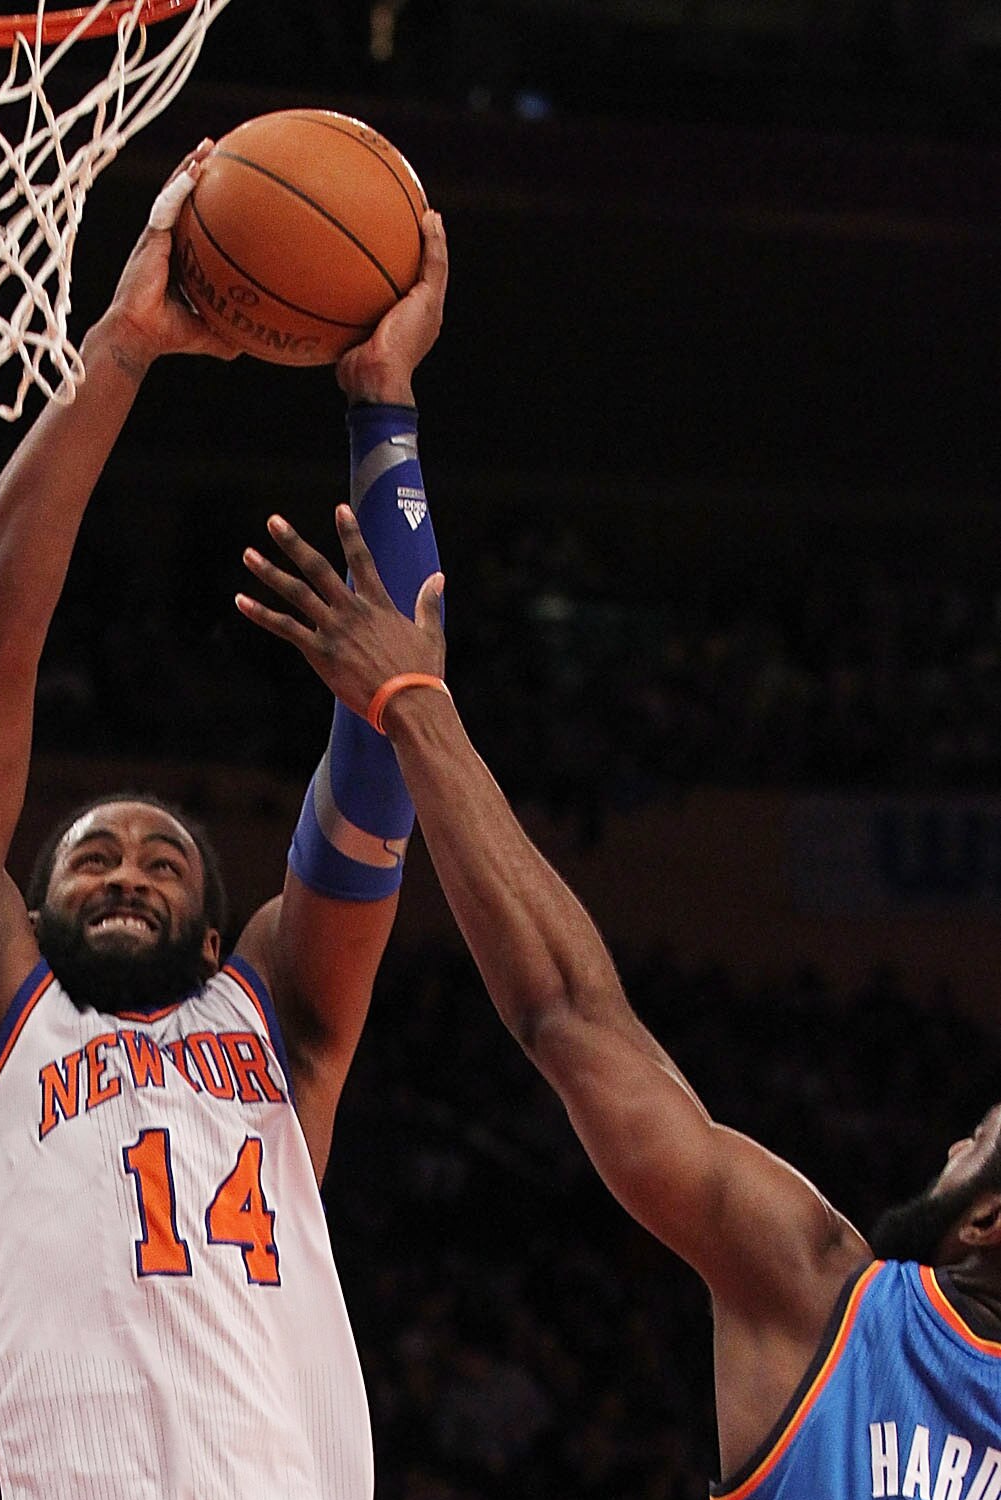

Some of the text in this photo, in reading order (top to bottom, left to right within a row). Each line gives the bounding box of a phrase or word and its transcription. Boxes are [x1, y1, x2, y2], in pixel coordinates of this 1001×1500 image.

[38, 1029, 288, 1142] NEW YOR
[121, 1127, 282, 1287] 14
